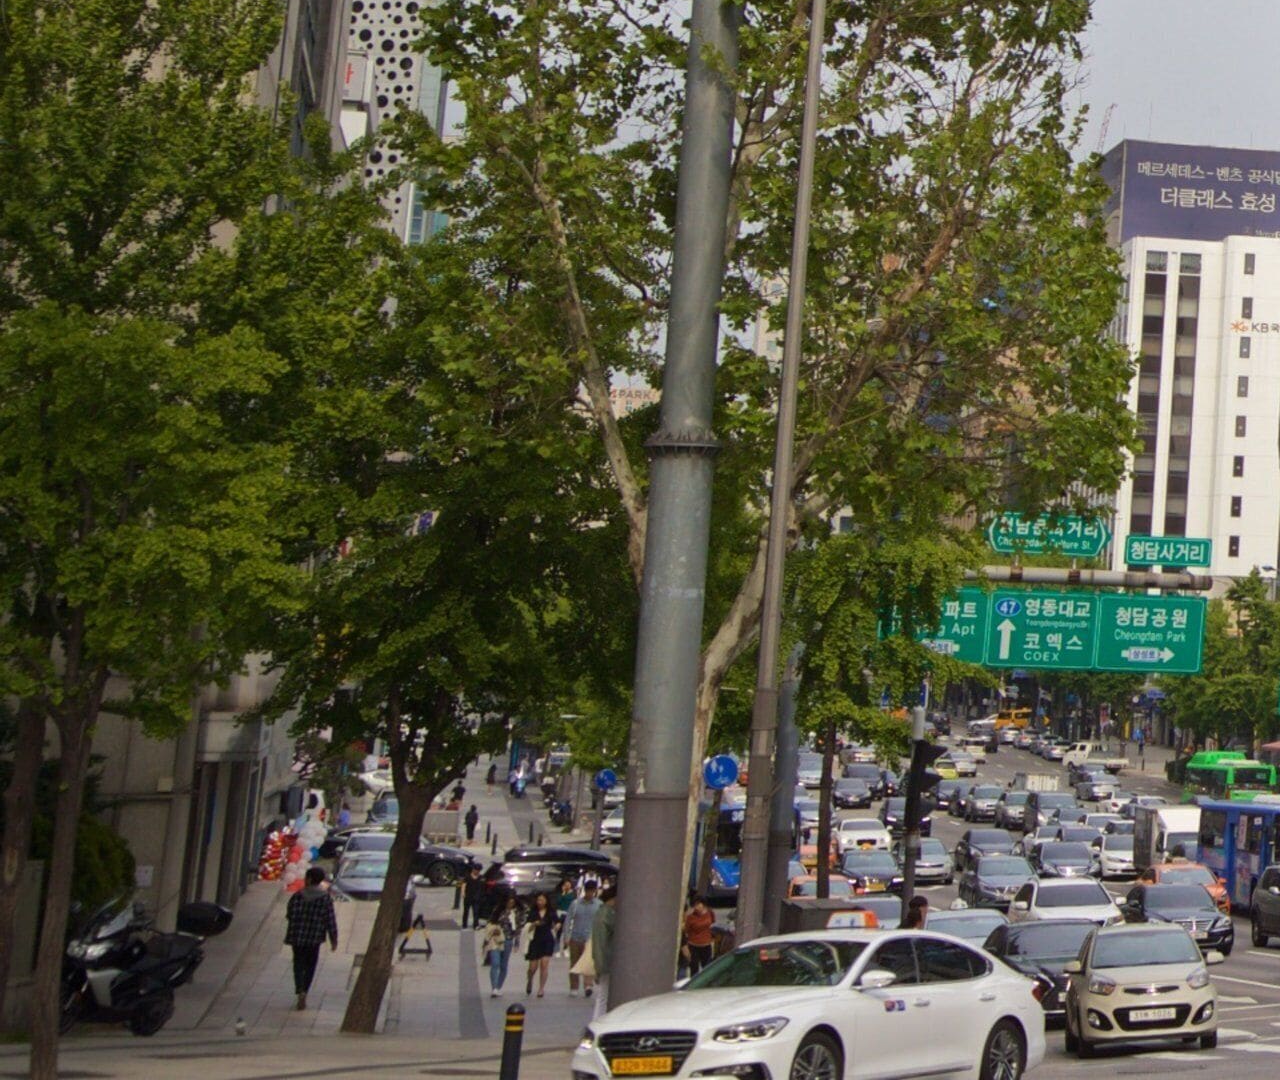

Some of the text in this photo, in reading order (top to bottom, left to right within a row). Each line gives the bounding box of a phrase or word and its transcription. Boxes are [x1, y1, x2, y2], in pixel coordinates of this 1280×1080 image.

[1160, 186, 1276, 213] 더클래스 효성
[1251, 322, 1269, 333] KB
[1131, 541, 1204, 562] 청담사거리
[1000, 600, 1017, 614] 47
[1025, 598, 1091, 618] 영동대교
[1116, 606, 1188, 629] 청담공원
[952, 623, 975, 637] Apt
[1114, 629, 1186, 642] Cheongdam Park
[1023, 633, 1083, 651] 코엑스
[1023, 651, 1060, 662] COEX
